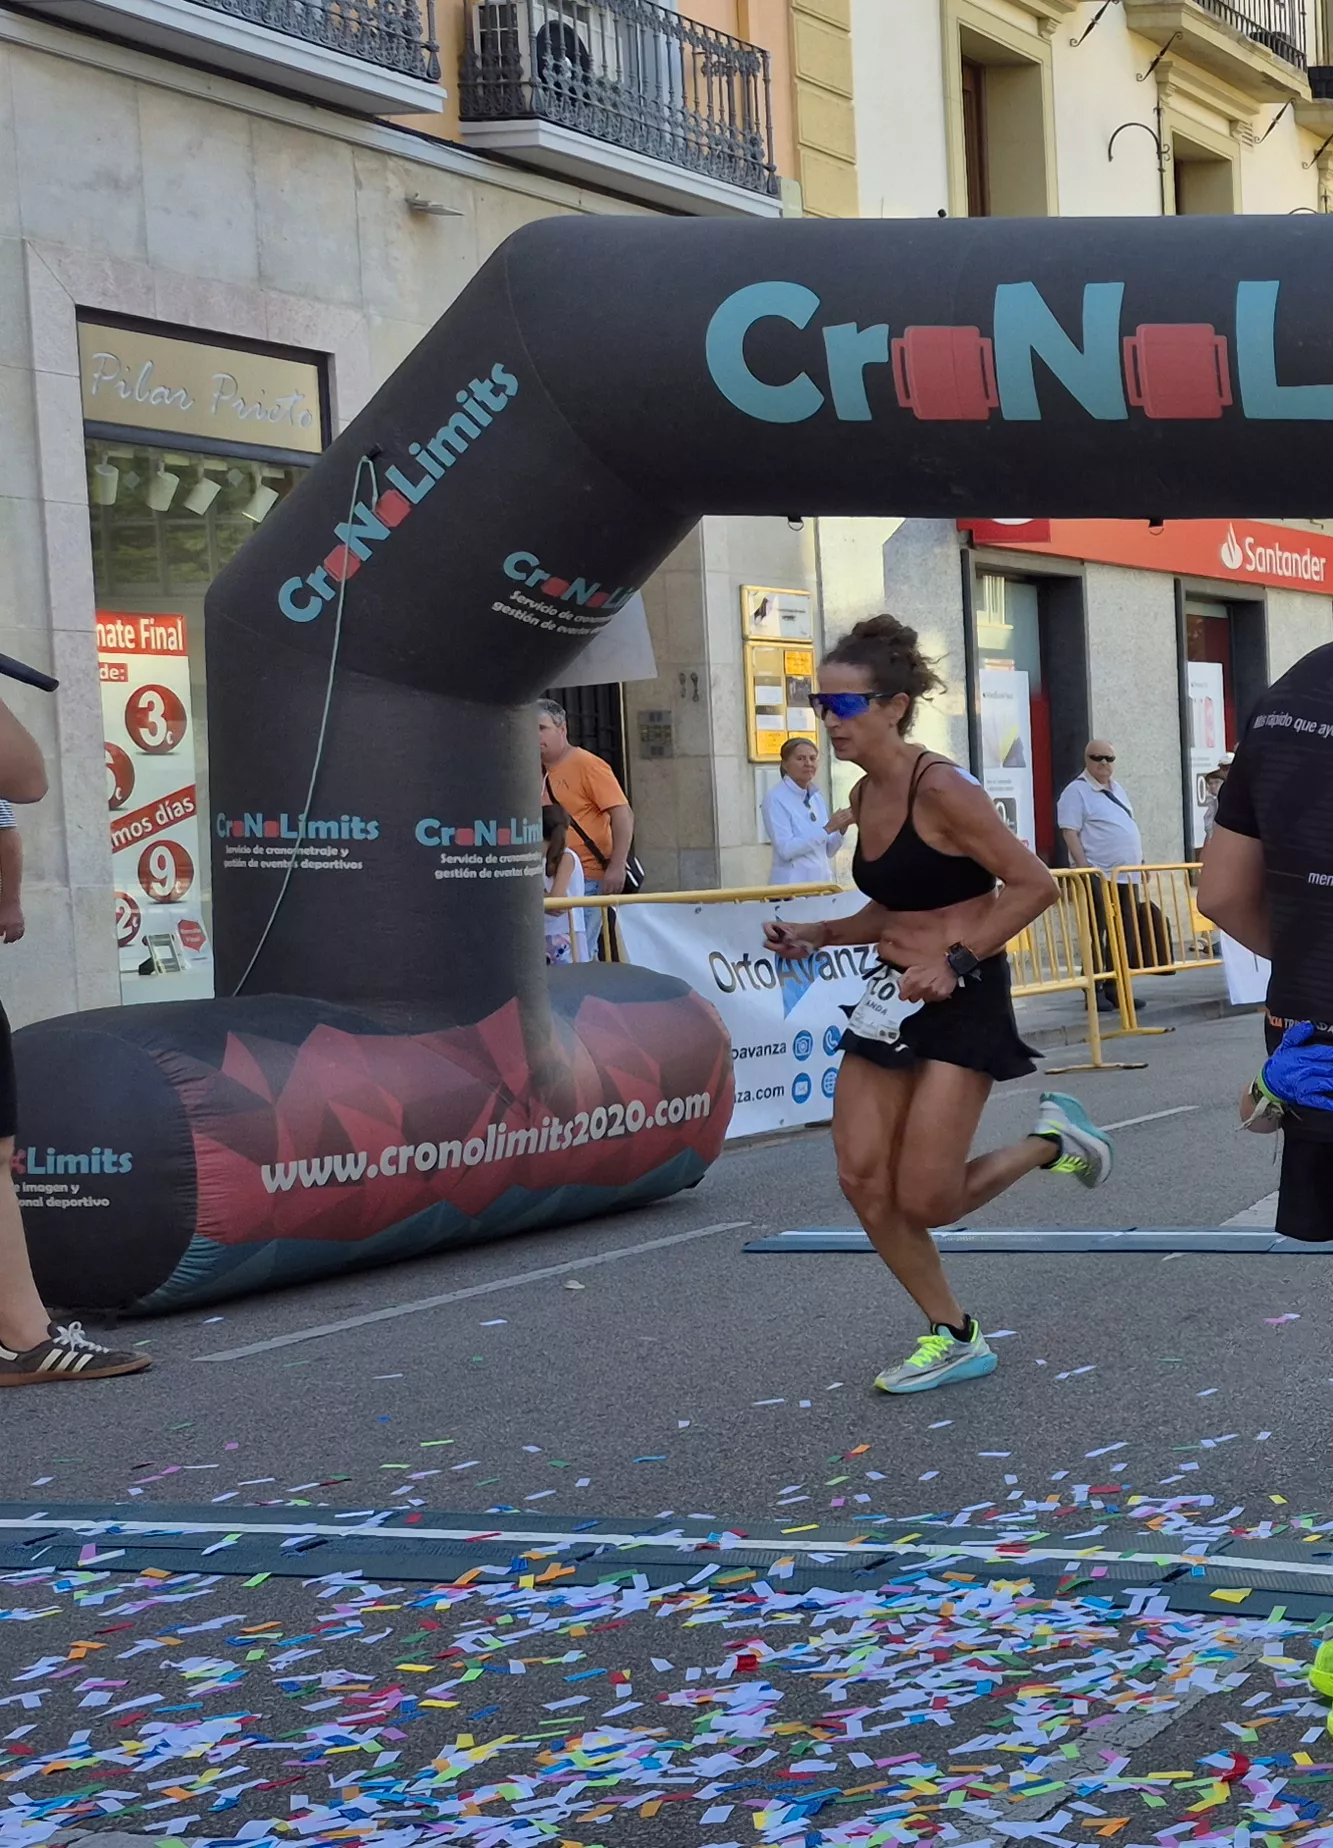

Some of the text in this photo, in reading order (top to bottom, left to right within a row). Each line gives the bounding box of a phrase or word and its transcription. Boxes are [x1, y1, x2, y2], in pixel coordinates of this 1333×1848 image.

[91, 352, 313, 428] Pilar Prieto
[1246, 536, 1326, 582] Santander
[491, 601, 540, 626] gestión
[510, 590, 558, 616] Servicio
[139, 617, 184, 651] Final
[1266, 711, 1292, 728] rápido
[1293, 718, 1317, 732] que
[156, 797, 195, 826] días
[340, 848, 349, 857] y
[440, 853, 483, 864] Servicio
[485, 853, 497, 864] de
[300, 859, 363, 870] deportivos
[434, 867, 477, 880] gestión
[479, 868, 492, 879] de
[261, 1091, 710, 1194] www.cronolimits2020.com
[22, 1182, 80, 1194] imagen y
[46, 1196, 110, 1209] deportivo
